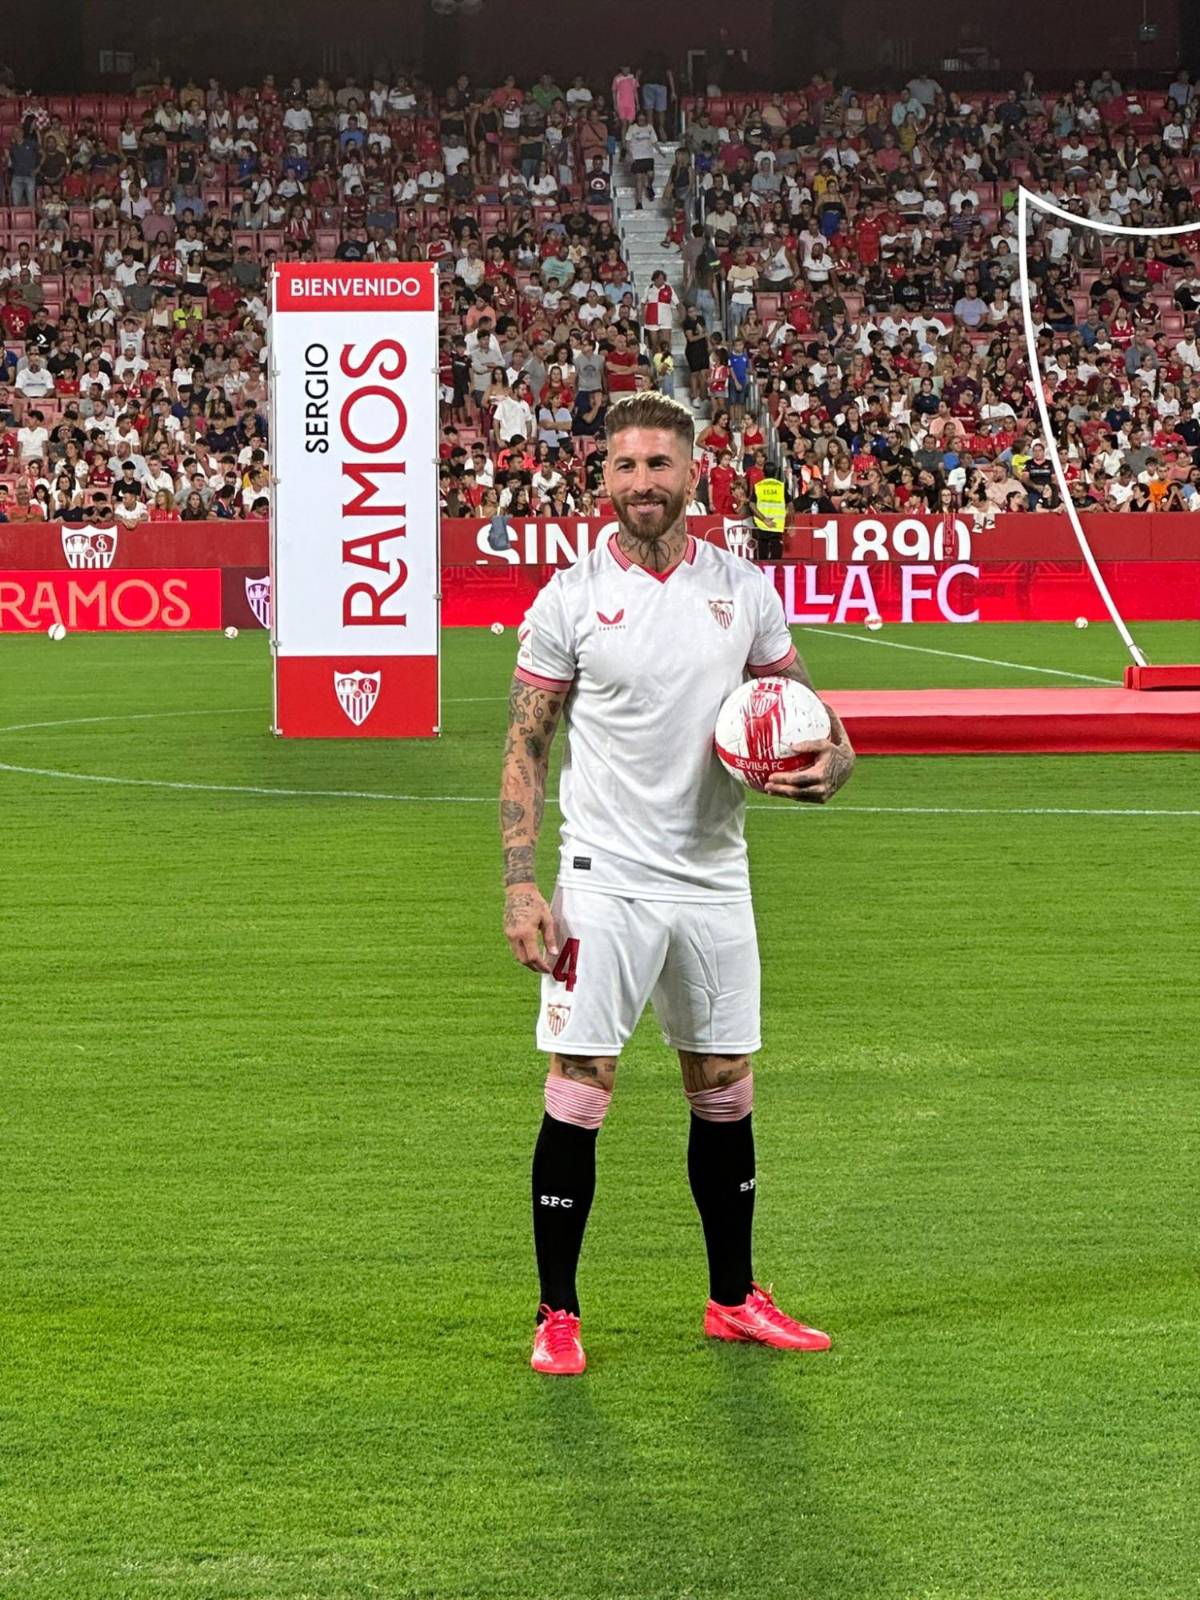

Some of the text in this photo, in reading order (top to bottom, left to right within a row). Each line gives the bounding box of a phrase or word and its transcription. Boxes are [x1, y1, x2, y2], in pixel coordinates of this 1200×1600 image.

[290, 276, 421, 298] BIENVENIDO
[304, 342, 330, 454] SERGIO
[339, 338, 409, 628] RAMOS
[812, 519, 972, 561] 1890
[0, 578, 191, 629] RAMOS
[900, 563, 980, 624] FC
[734, 757, 785, 772] SEVILLA FC
[552, 937, 580, 992] 4
[540, 1195, 573, 1208] SFC
